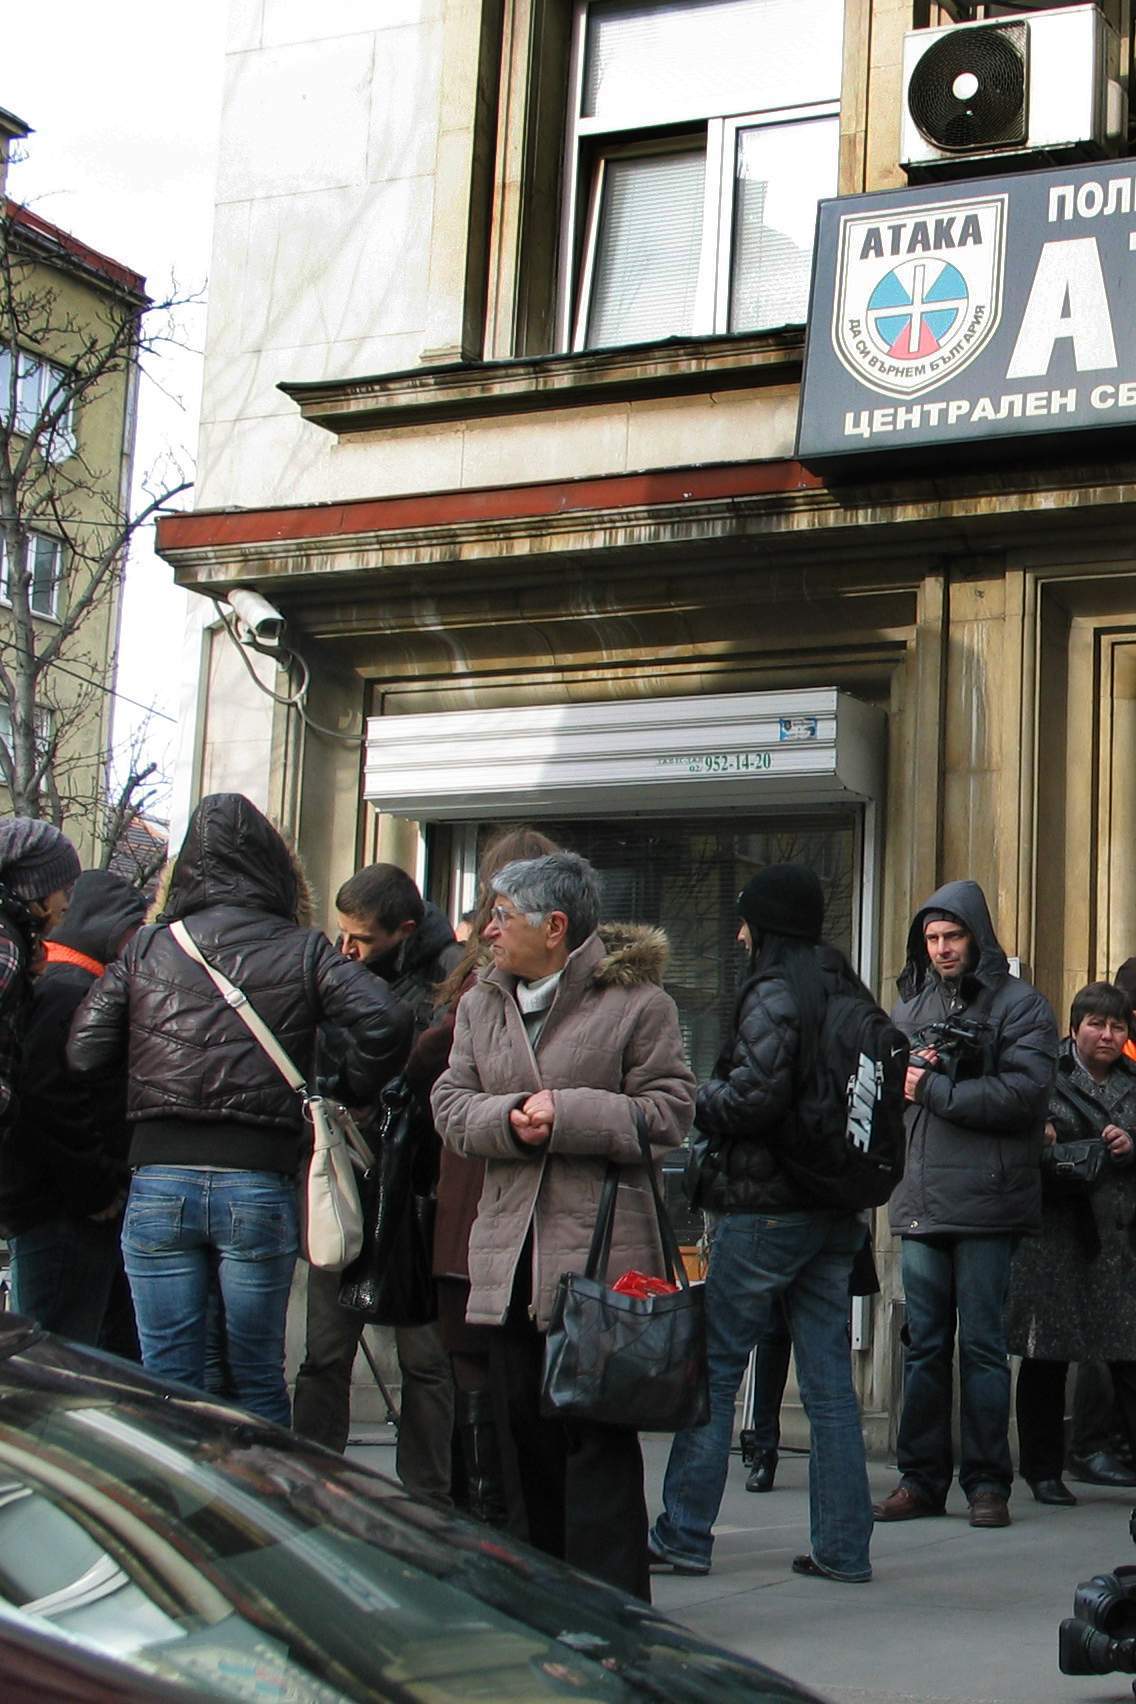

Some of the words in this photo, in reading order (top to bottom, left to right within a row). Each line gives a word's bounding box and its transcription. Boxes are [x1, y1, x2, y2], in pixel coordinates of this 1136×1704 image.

[859, 213, 984, 260] АТАКА
[849, 319, 861, 339] ДА
[856, 340, 871, 359] СИ
[868, 356, 926, 378] ВЪРНЕМ
[843, 389, 1077, 438] ЦЕНТРАЛЕН
[704, 752, 771, 771] 952-14-20
[846, 1052, 876, 1153] NIKE
